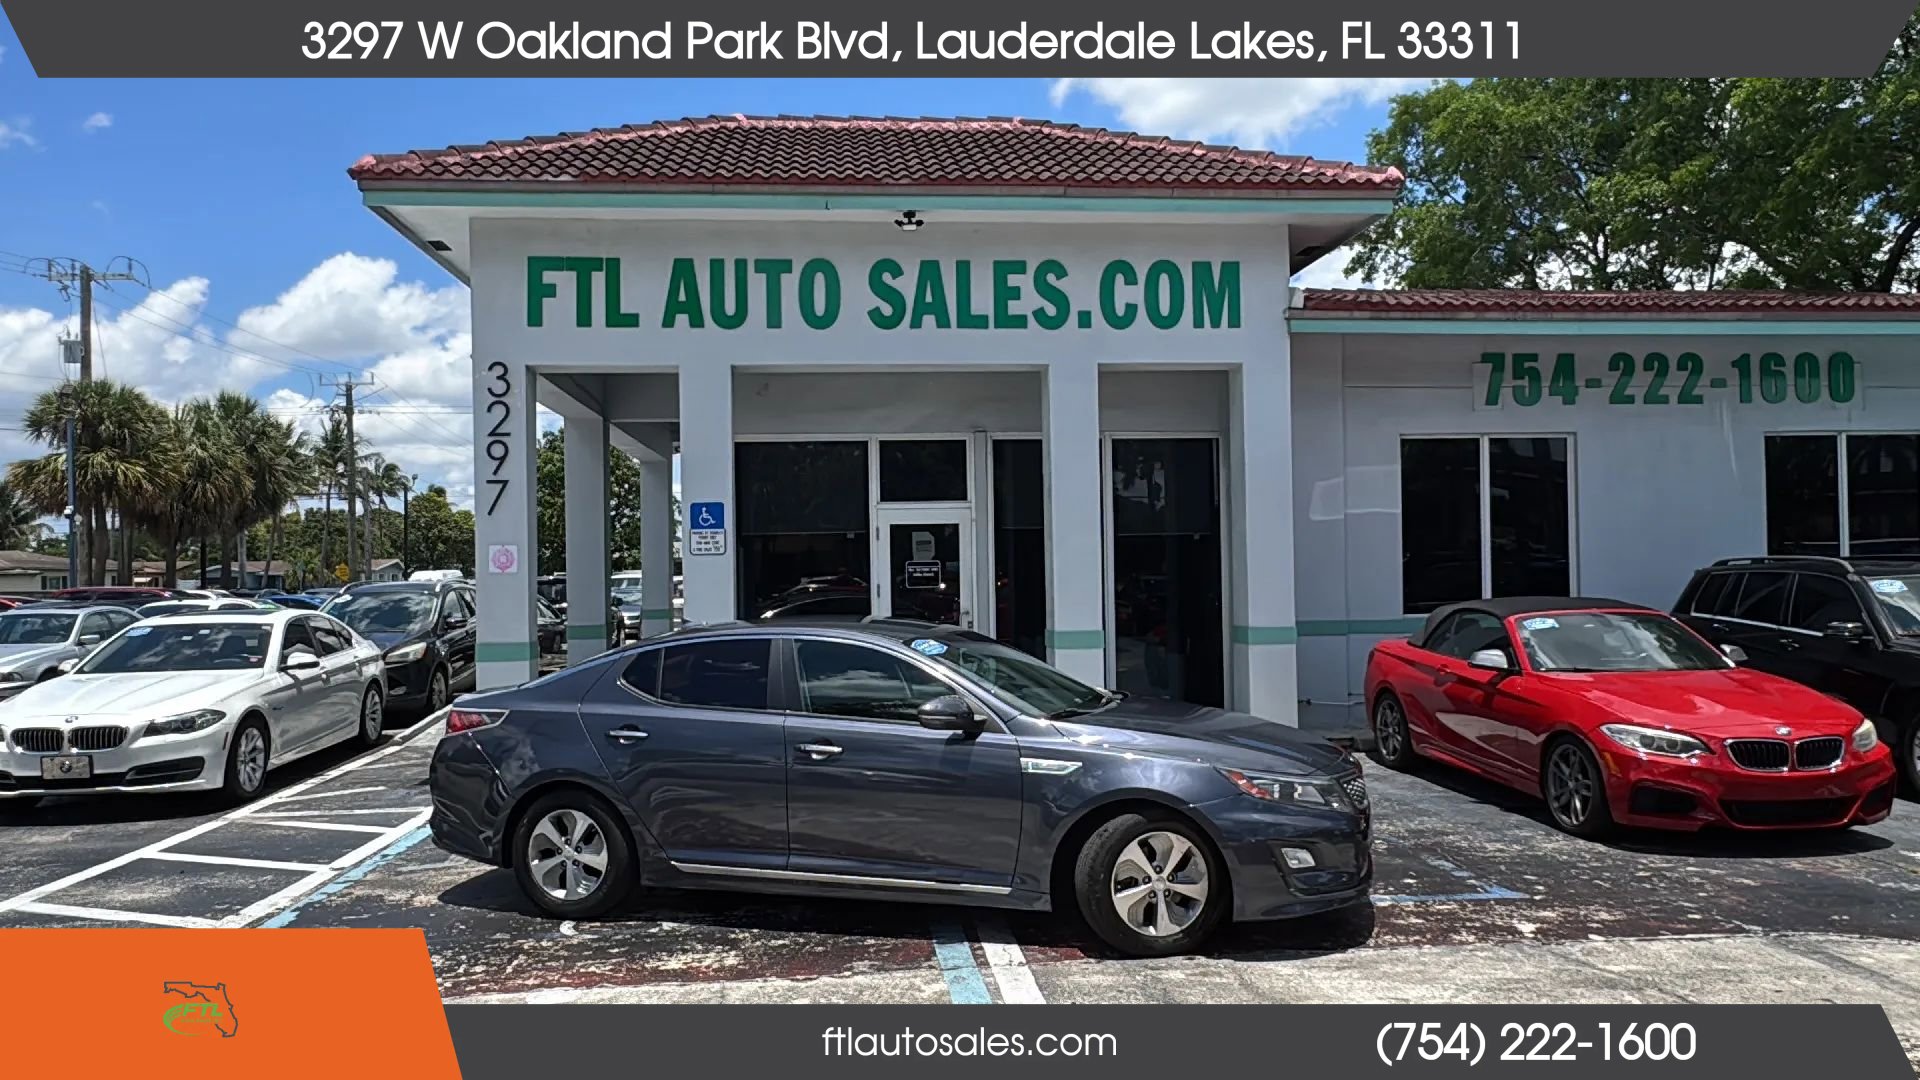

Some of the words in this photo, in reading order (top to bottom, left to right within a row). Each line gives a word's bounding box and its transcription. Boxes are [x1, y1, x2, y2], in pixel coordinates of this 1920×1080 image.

[527, 256, 640, 328] FTL
[662, 257, 841, 330] AUTO
[868, 259, 1242, 331] SALES.COM
[1480, 351, 1856, 406] 754-222-1600
[485, 361, 511, 516] 3297
